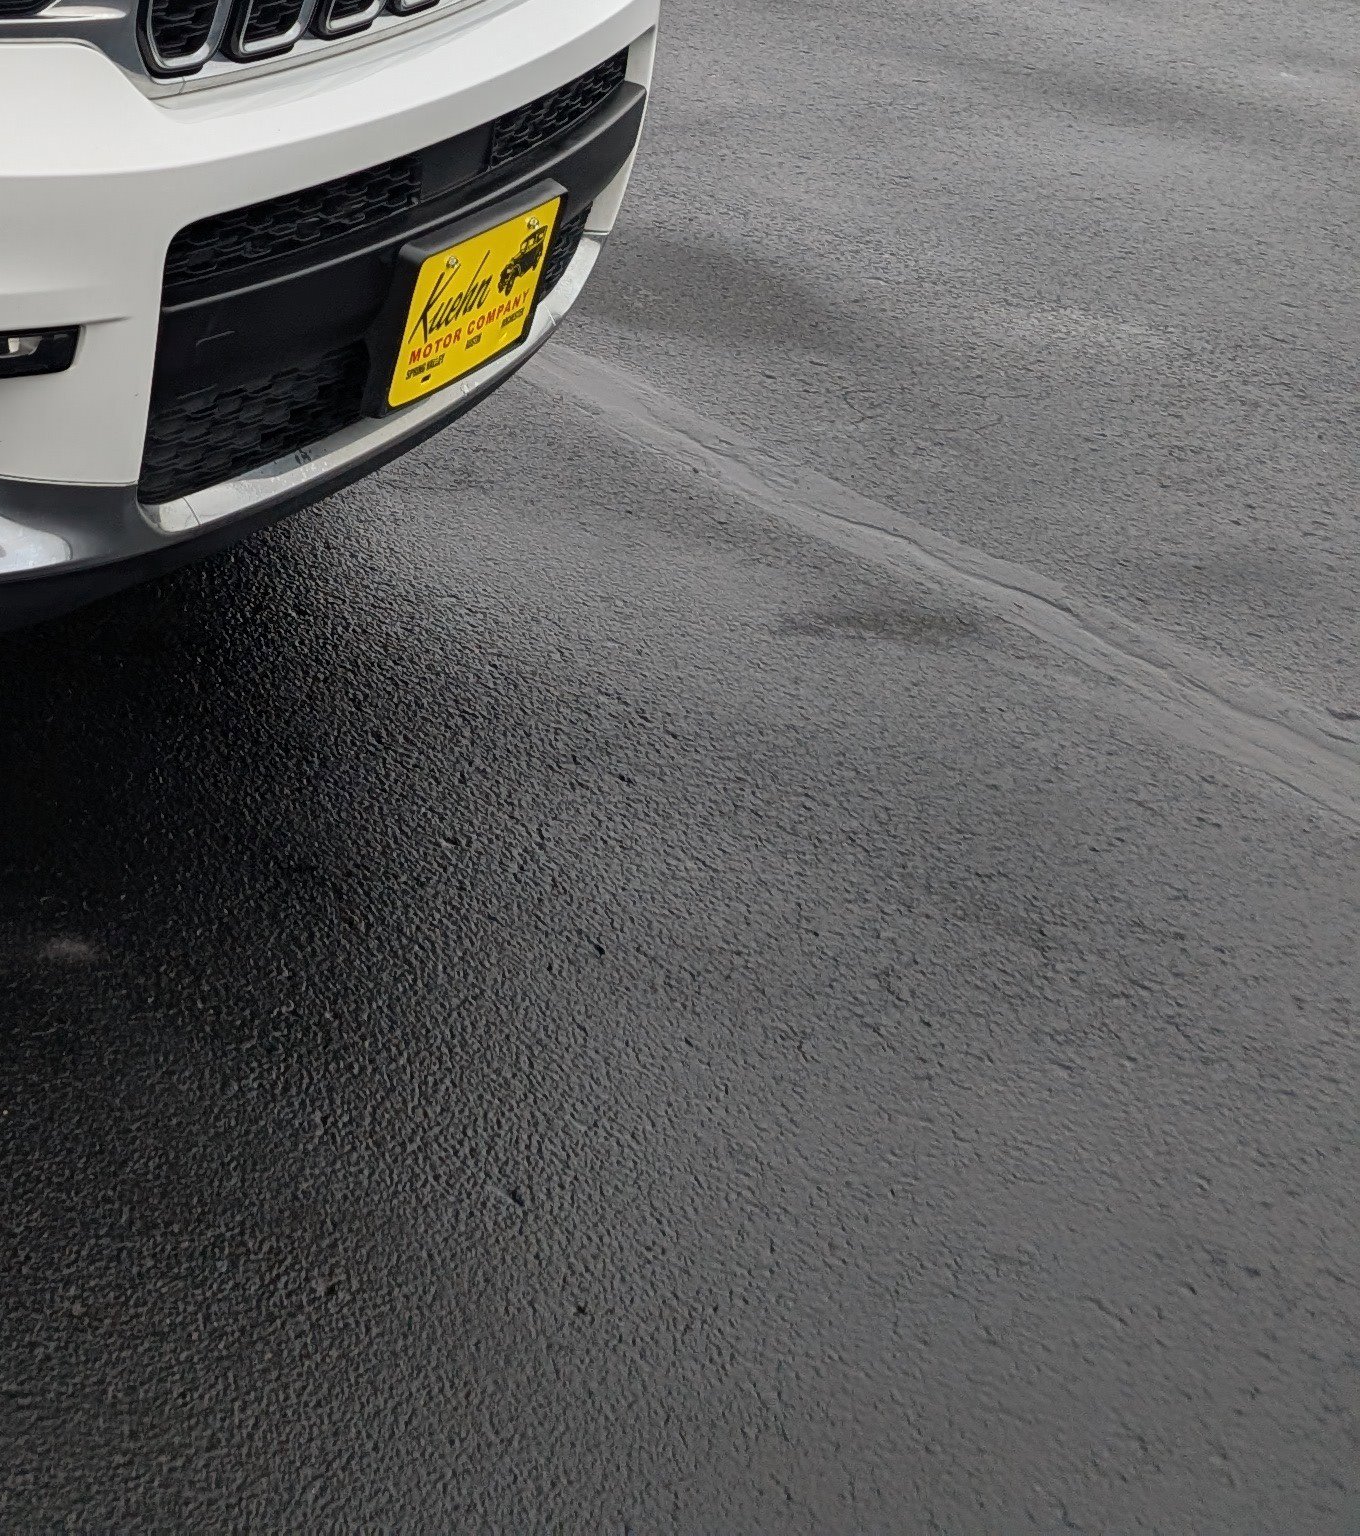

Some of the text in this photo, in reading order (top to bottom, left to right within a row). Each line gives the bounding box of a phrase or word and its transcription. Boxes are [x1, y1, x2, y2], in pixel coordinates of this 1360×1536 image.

[407, 249, 493, 346] Kuehn
[408, 327, 462, 365] MOTOR
[466, 287, 530, 336] COMPANY
